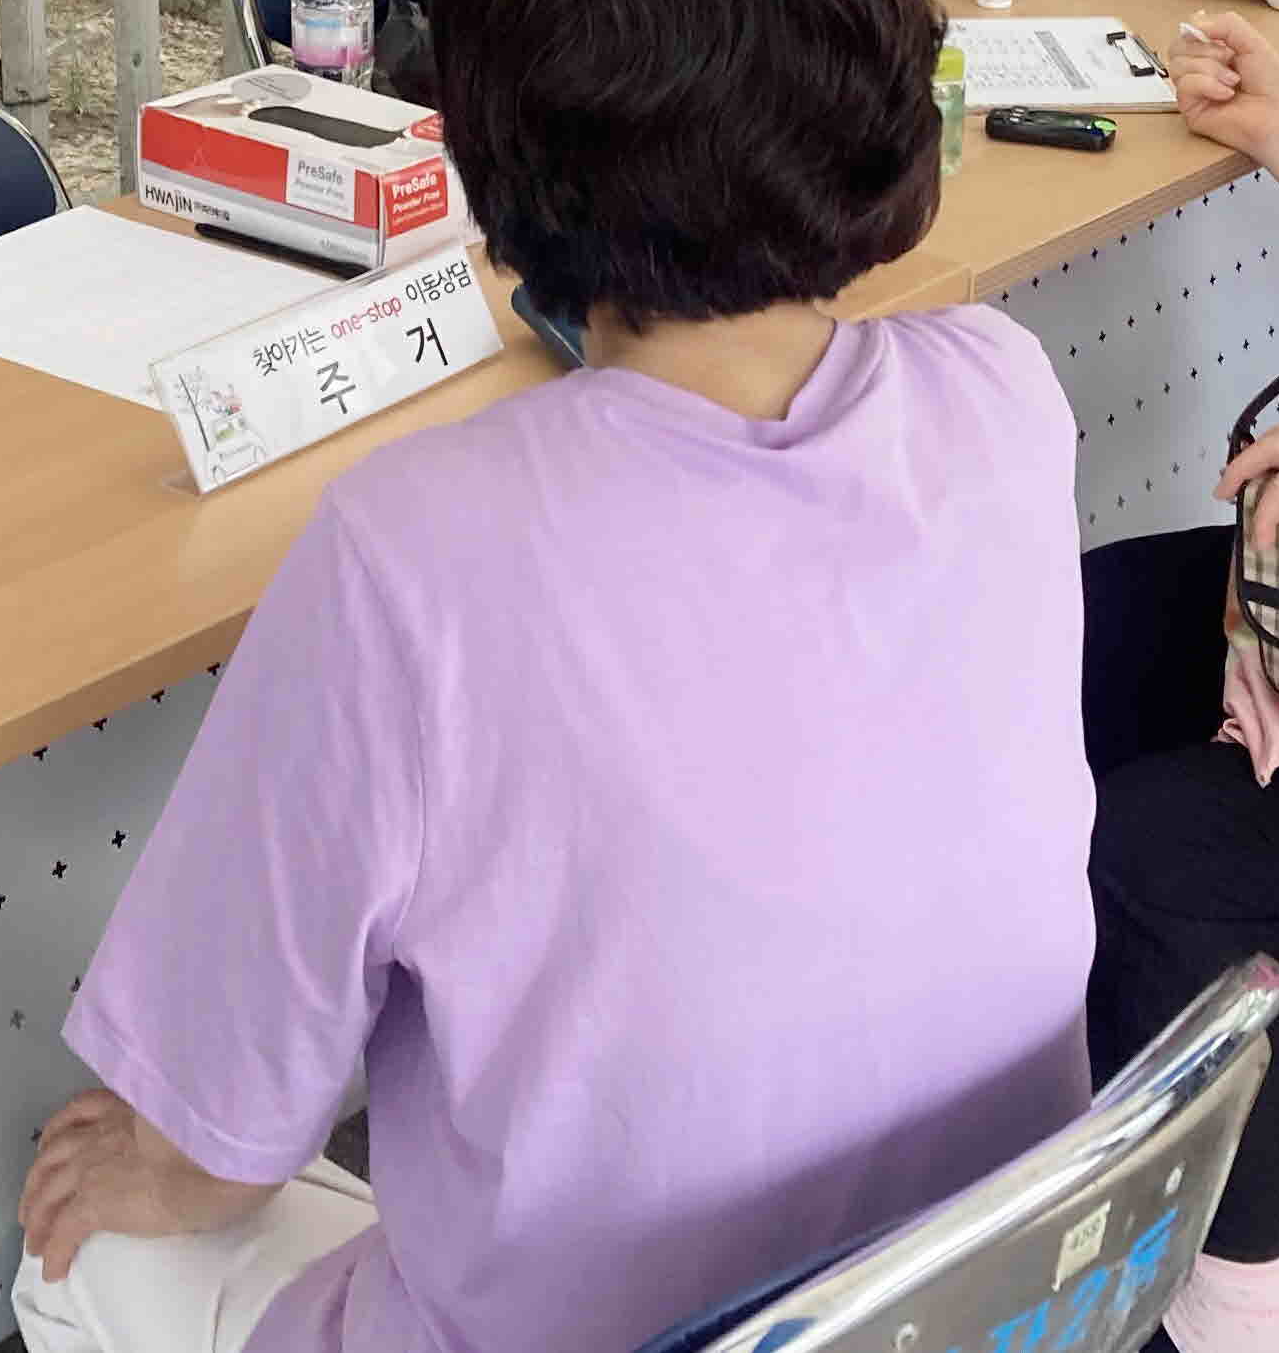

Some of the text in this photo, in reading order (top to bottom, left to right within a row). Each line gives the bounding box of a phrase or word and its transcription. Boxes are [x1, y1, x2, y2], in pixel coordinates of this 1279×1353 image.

[391, 172, 438, 199] PreSafe
[252, 260, 472, 376] 찾아가는 one-stop 이동상담
[315, 316, 451, 415] 주 거
